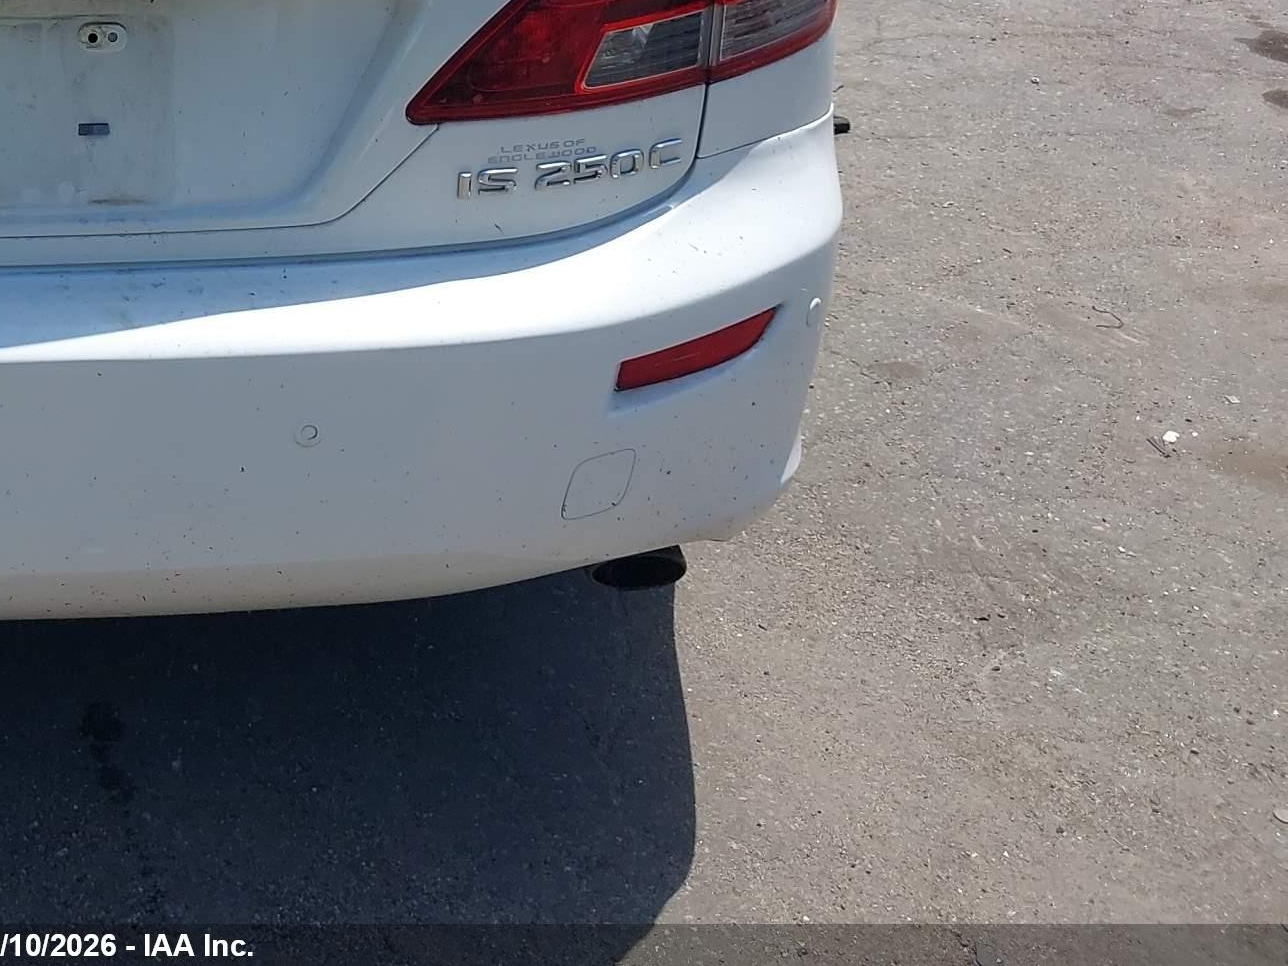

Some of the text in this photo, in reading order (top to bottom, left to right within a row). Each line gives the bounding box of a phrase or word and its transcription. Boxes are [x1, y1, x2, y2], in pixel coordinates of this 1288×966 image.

[500, 138, 585, 154] LEXUS OF
[456, 166, 519, 201] IS
